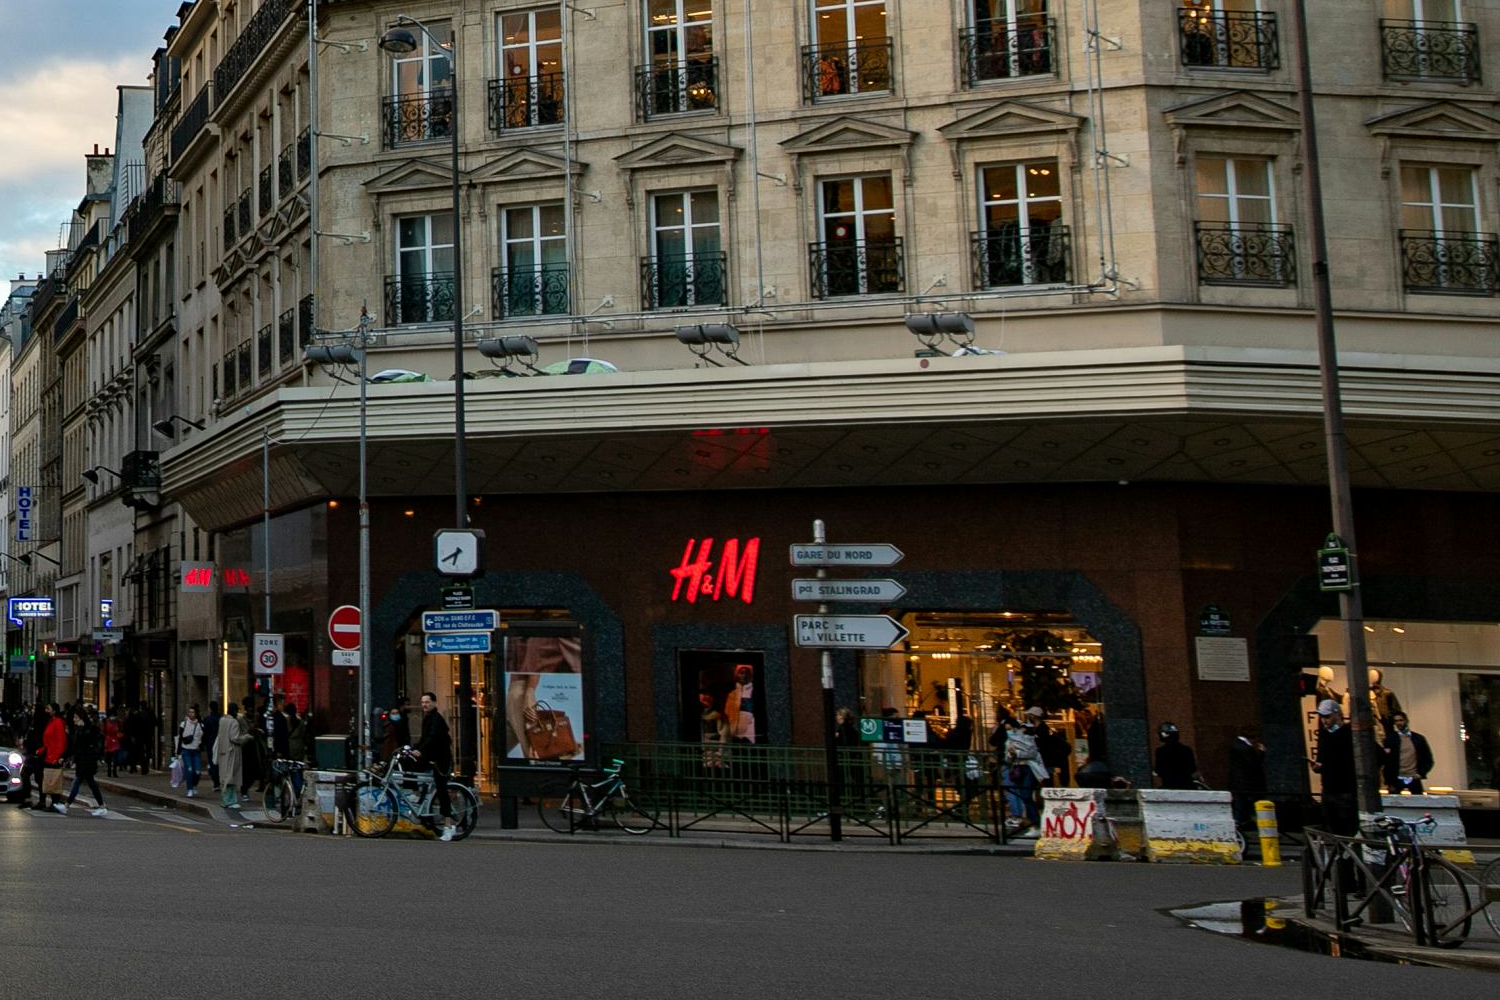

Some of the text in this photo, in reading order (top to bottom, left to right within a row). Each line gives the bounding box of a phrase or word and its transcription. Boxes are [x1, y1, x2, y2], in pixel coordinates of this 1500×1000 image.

[19, 487, 31, 540] HOTEL
[797, 551, 873, 560] GARE DU NORD
[669, 536, 762, 606] H&M
[819, 586, 881, 595] STALINGRAD
[14, 602, 54, 611] HOTEL
[801, 621, 829, 630] PARC
[817, 633, 865, 642] VILLETTE
[264, 654, 274, 663] 30
